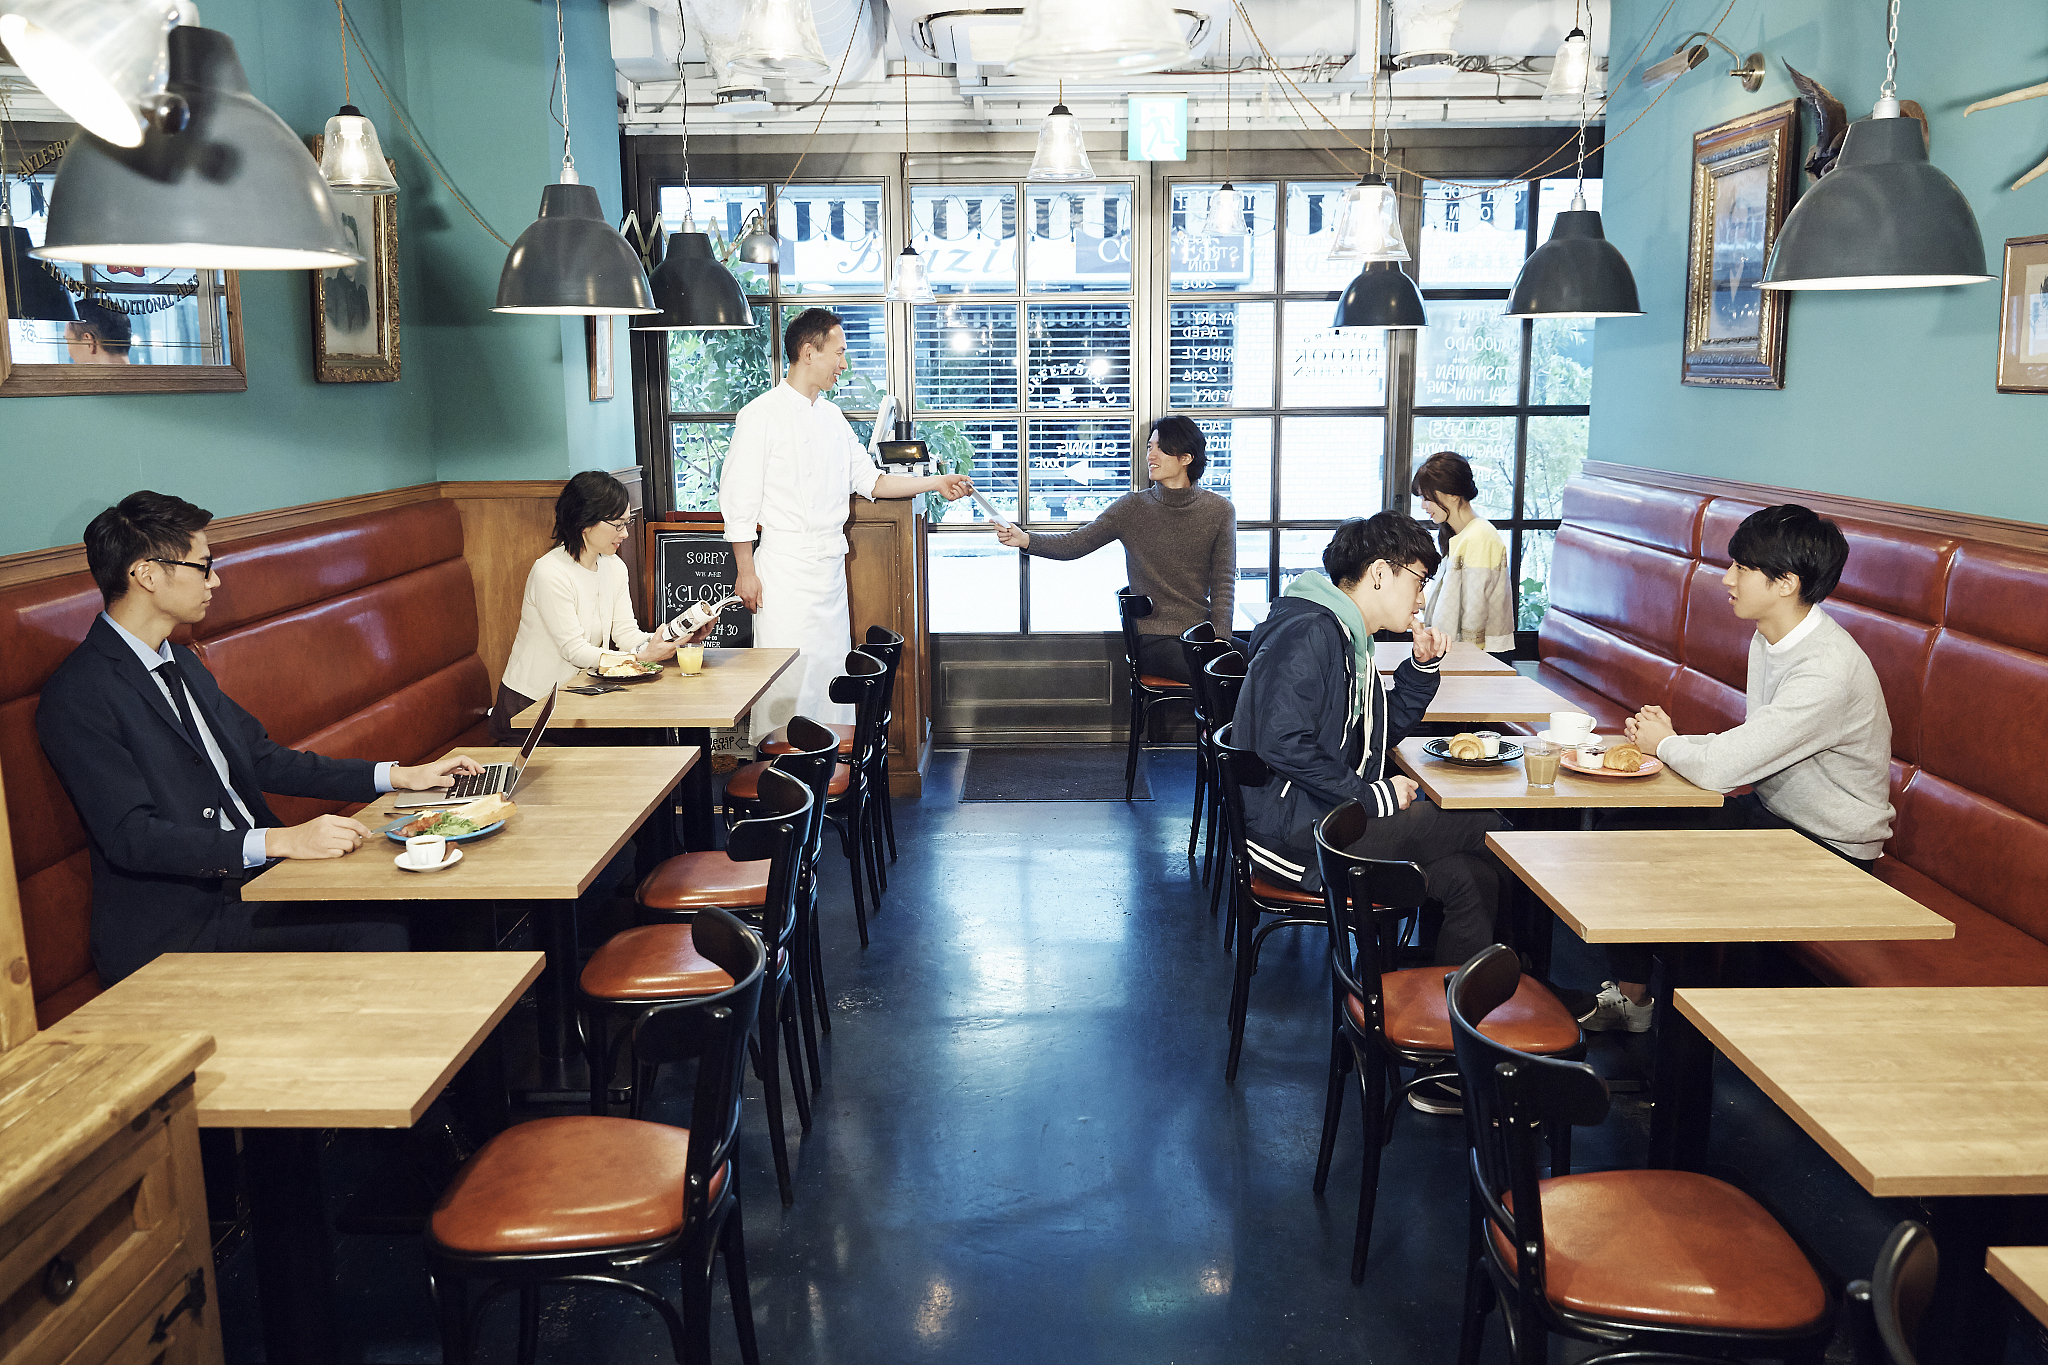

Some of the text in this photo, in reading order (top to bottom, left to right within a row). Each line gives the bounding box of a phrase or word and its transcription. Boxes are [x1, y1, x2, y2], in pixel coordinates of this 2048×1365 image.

[96, 286, 175, 315] TRADITIONAL
[176, 274, 200, 302] ALES
[686, 551, 729, 565] SORRY
[675, 582, 734, 603] CLOSE
